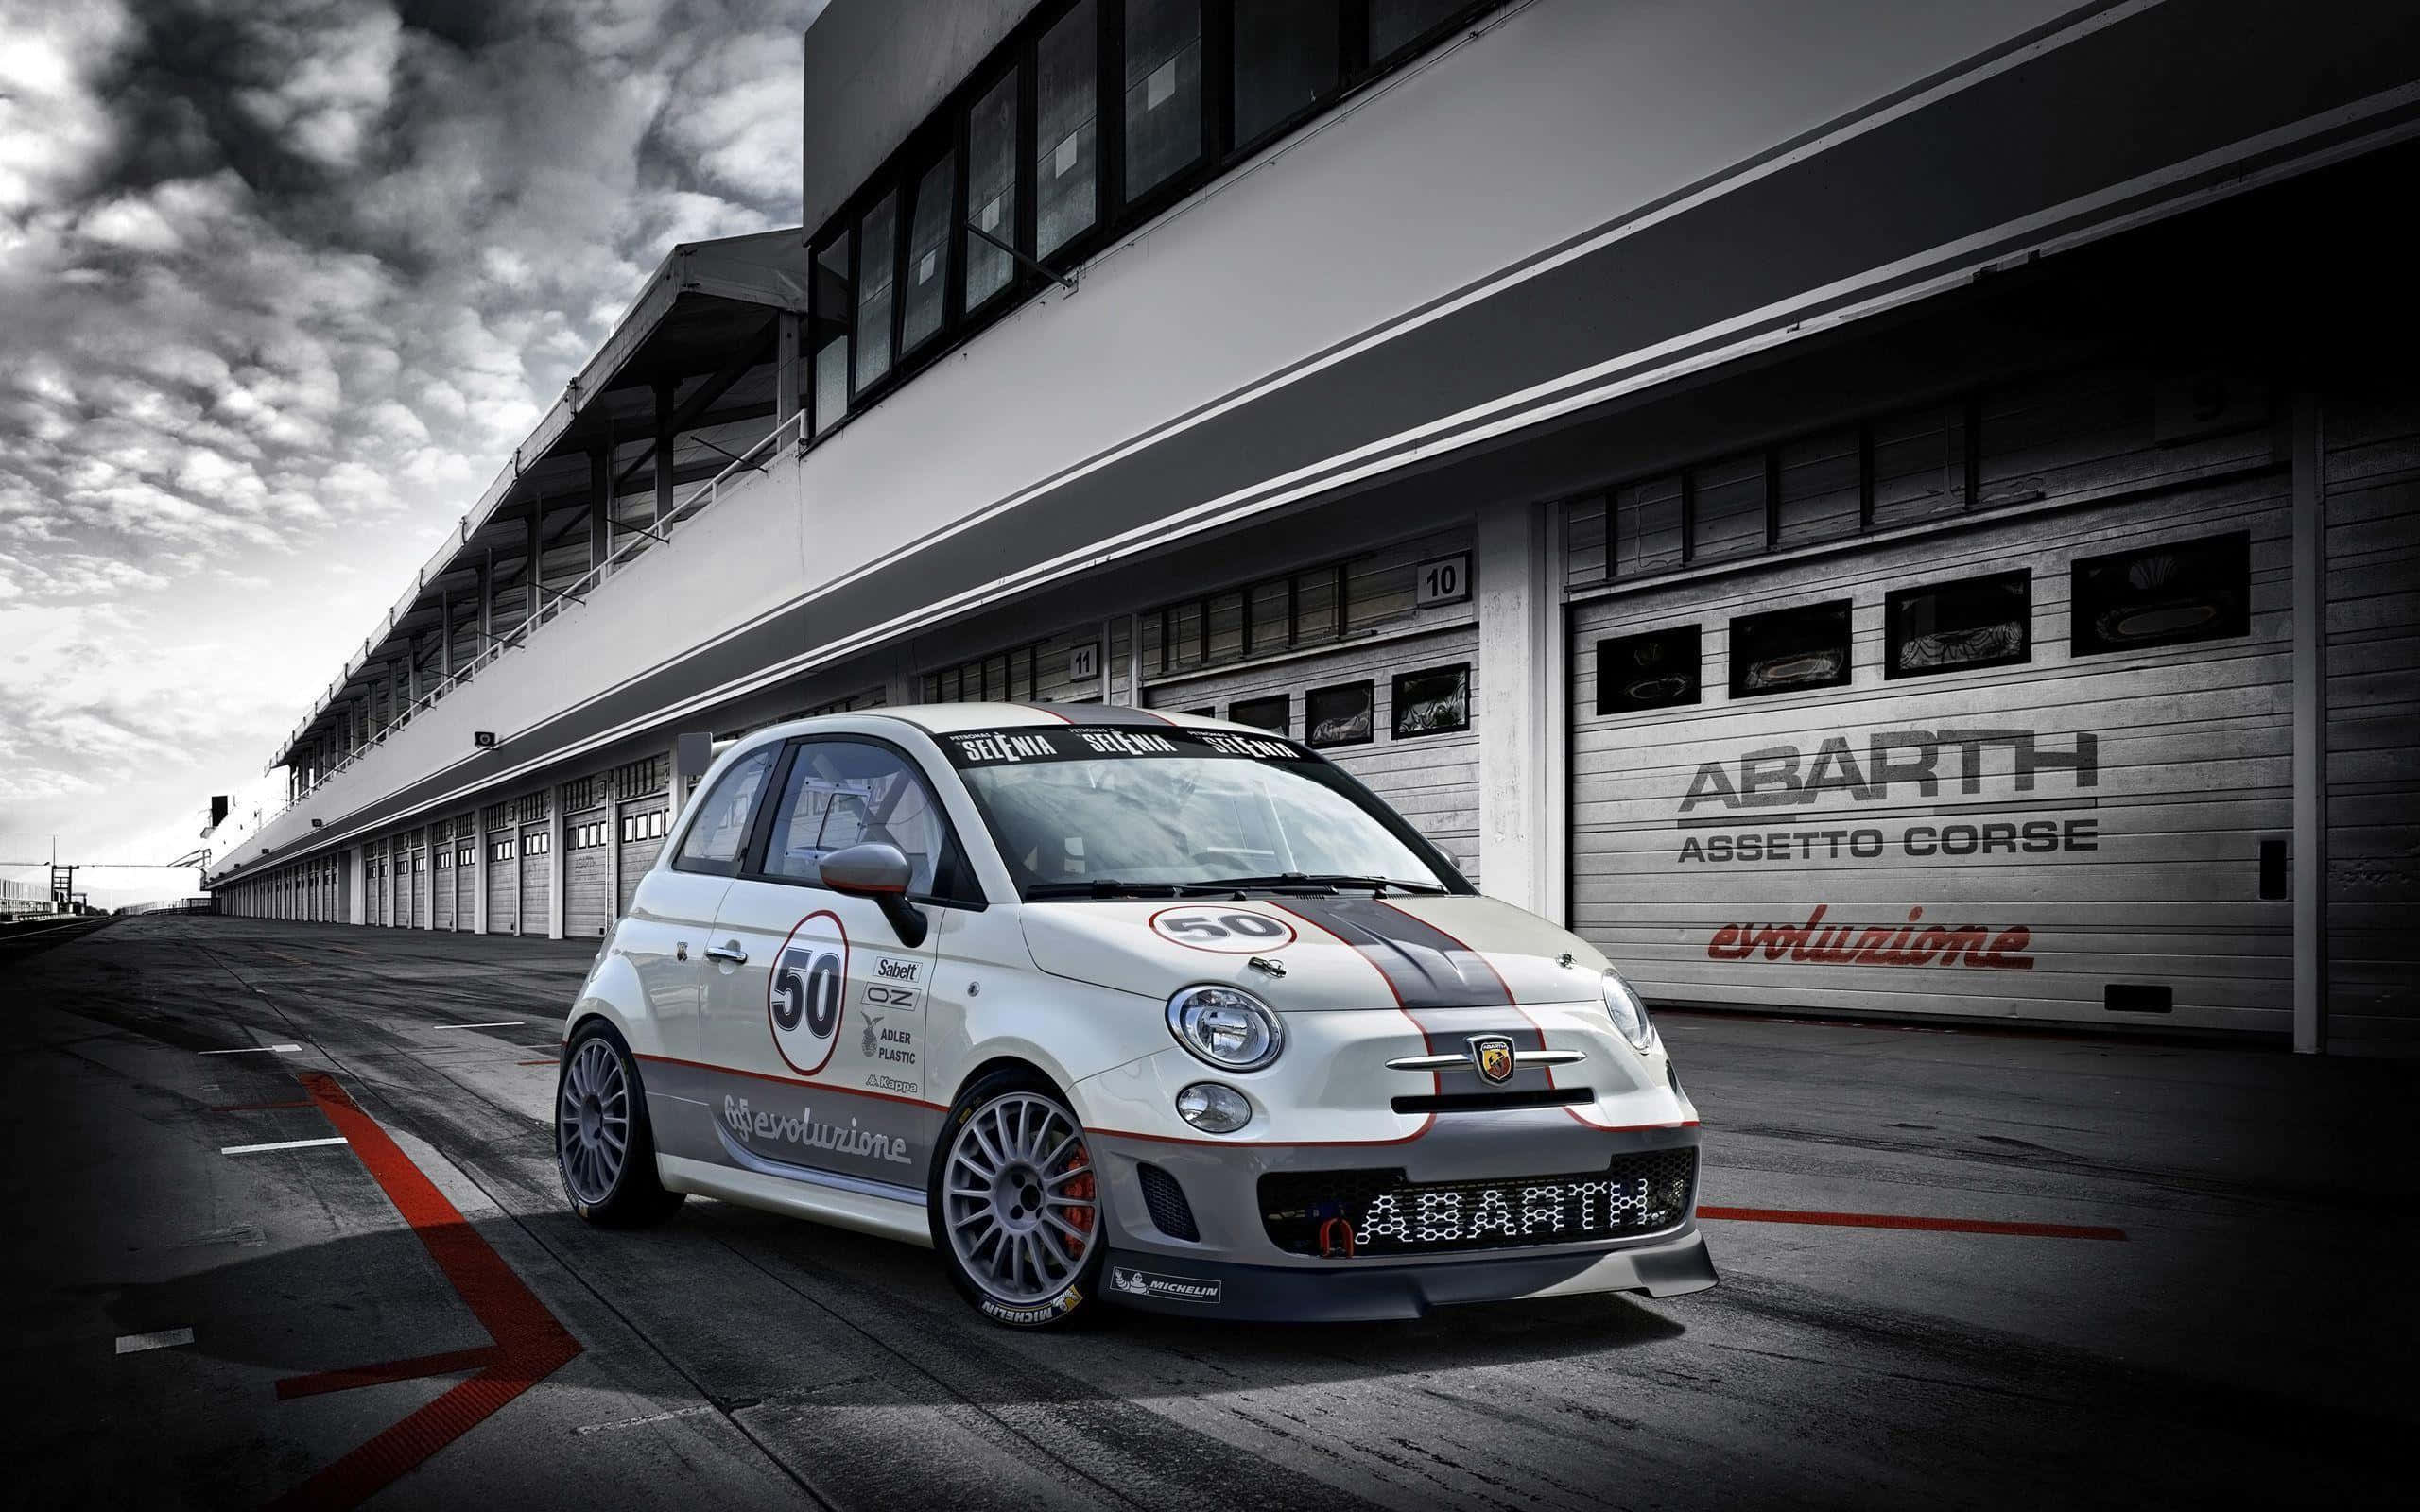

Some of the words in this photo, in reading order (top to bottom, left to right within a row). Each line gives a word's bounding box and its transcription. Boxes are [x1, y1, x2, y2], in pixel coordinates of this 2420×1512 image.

[1426, 564, 1457, 598] 10
[1075, 650, 1091, 675] 11
[1677, 729, 2099, 813] ABARTH
[1677, 828, 1884, 863] ASSETTO
[1903, 818, 2099, 856] CORSE
[1159, 914, 1287, 942] 50
[1706, 903, 2035, 970] evoluzione
[878, 958, 917, 980] Sabelt
[770, 946, 841, 1040] 50
[880, 1027, 911, 1045] ADLER
[878, 1046, 916, 1065] PLASTIC
[879, 1075, 918, 1094] Kappa
[754, 1108, 912, 1165] evoluzione
[1354, 1178, 1649, 1245] ABARTH
[1149, 1280, 1219, 1297] MICHELIN
[980, 1299, 1054, 1324] MICHELIN
